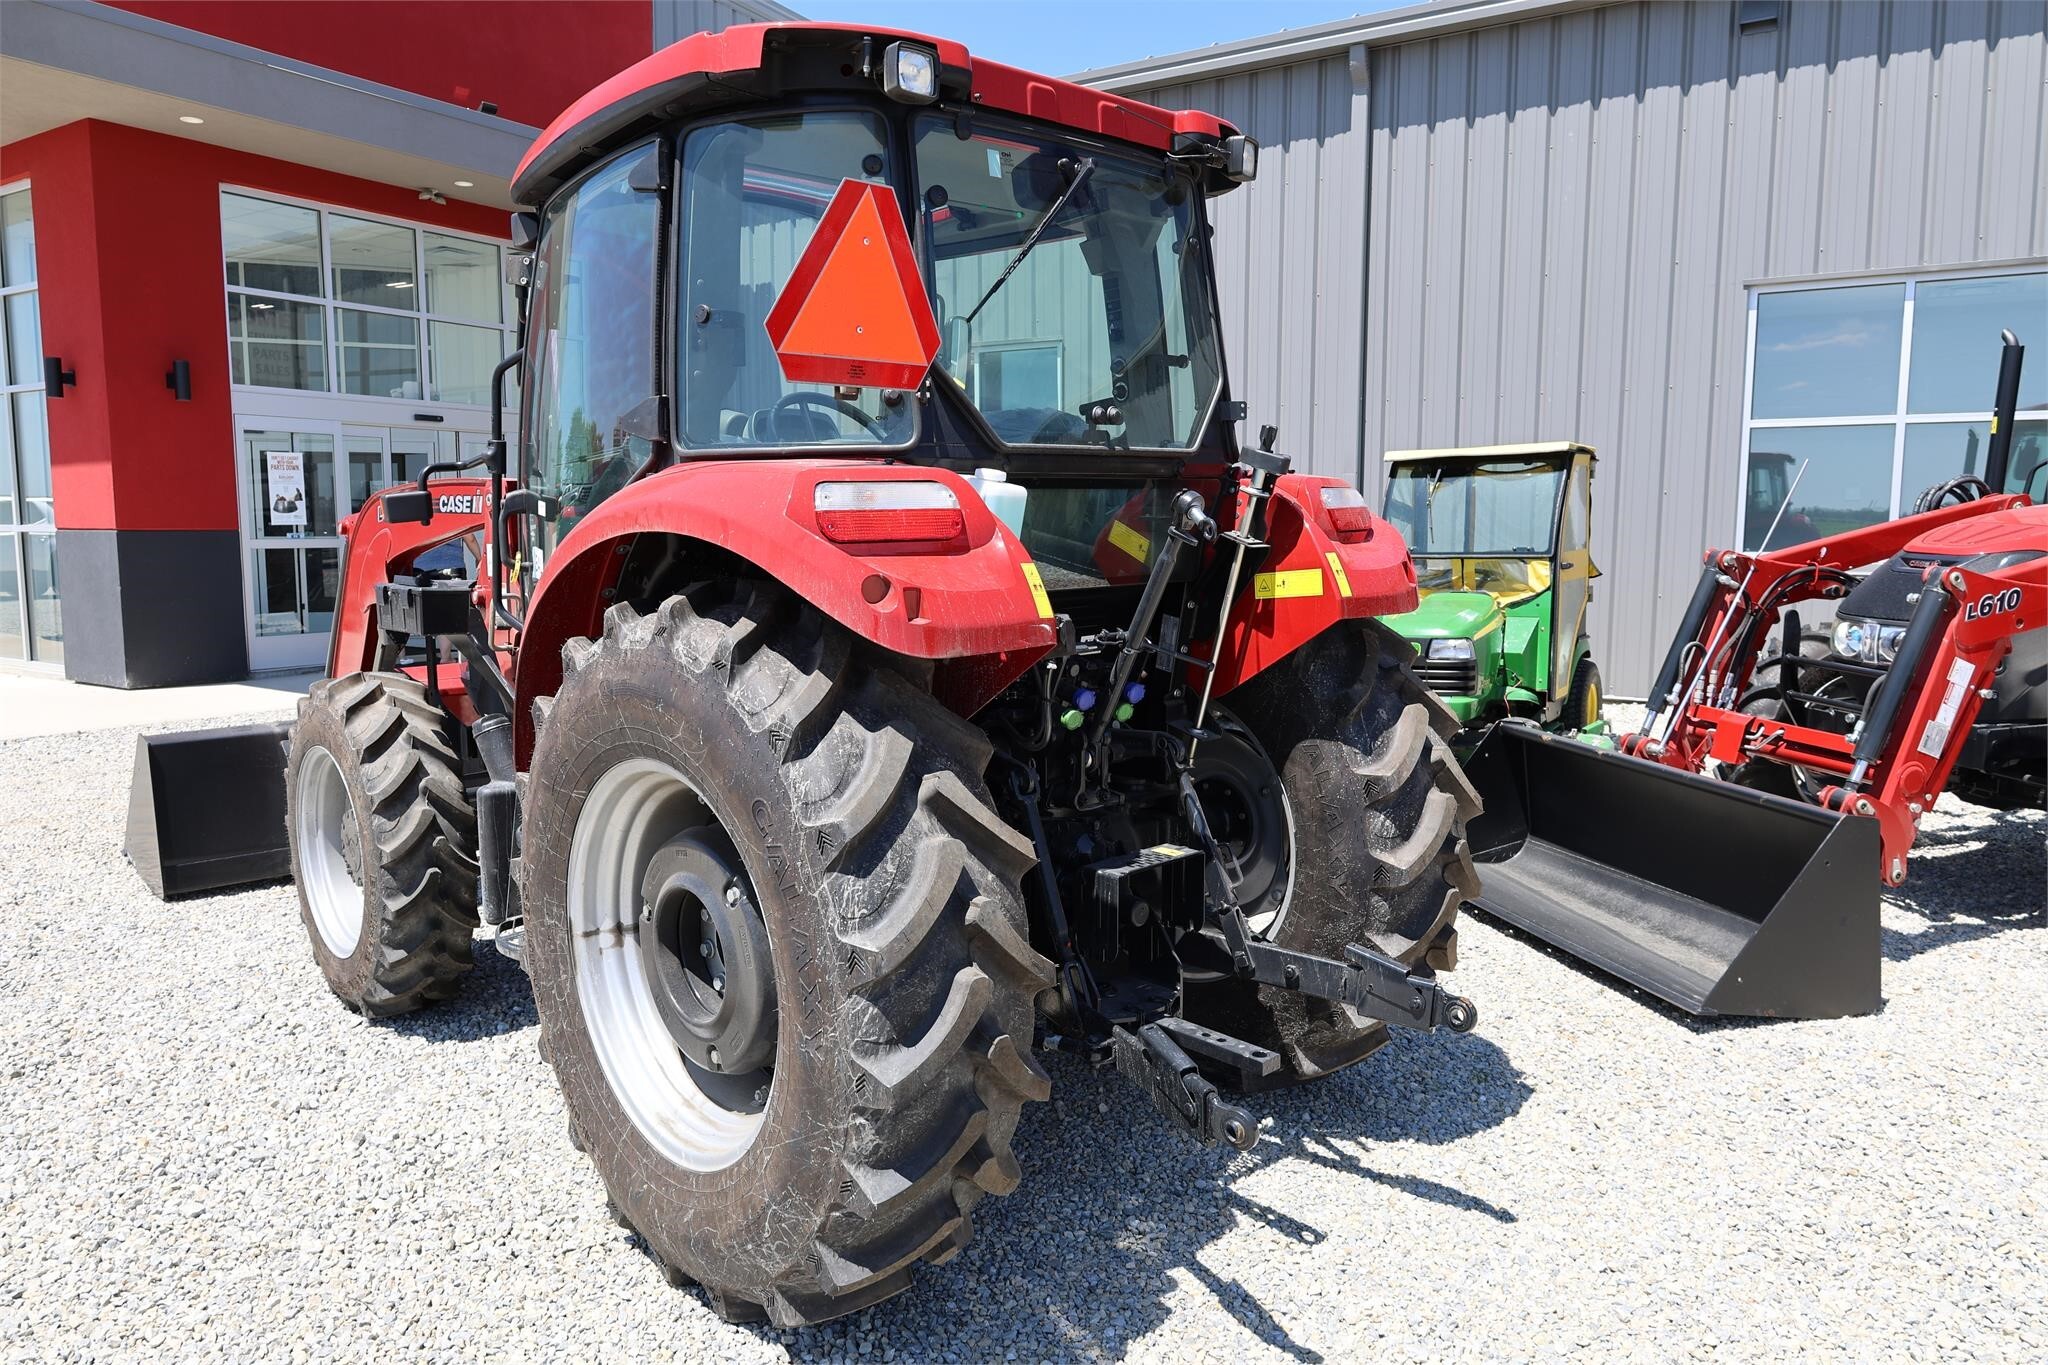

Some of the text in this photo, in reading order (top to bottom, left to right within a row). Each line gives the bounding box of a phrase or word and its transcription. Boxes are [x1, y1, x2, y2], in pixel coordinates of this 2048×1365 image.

[252, 347, 290, 362] PARTS
[255, 363, 291, 377] SALES
[439, 494, 472, 513] CASE
[1964, 587, 2023, 622] L610
[1301, 743, 1351, 902] ALAXY
[751, 797, 826, 1061] GALAXY
